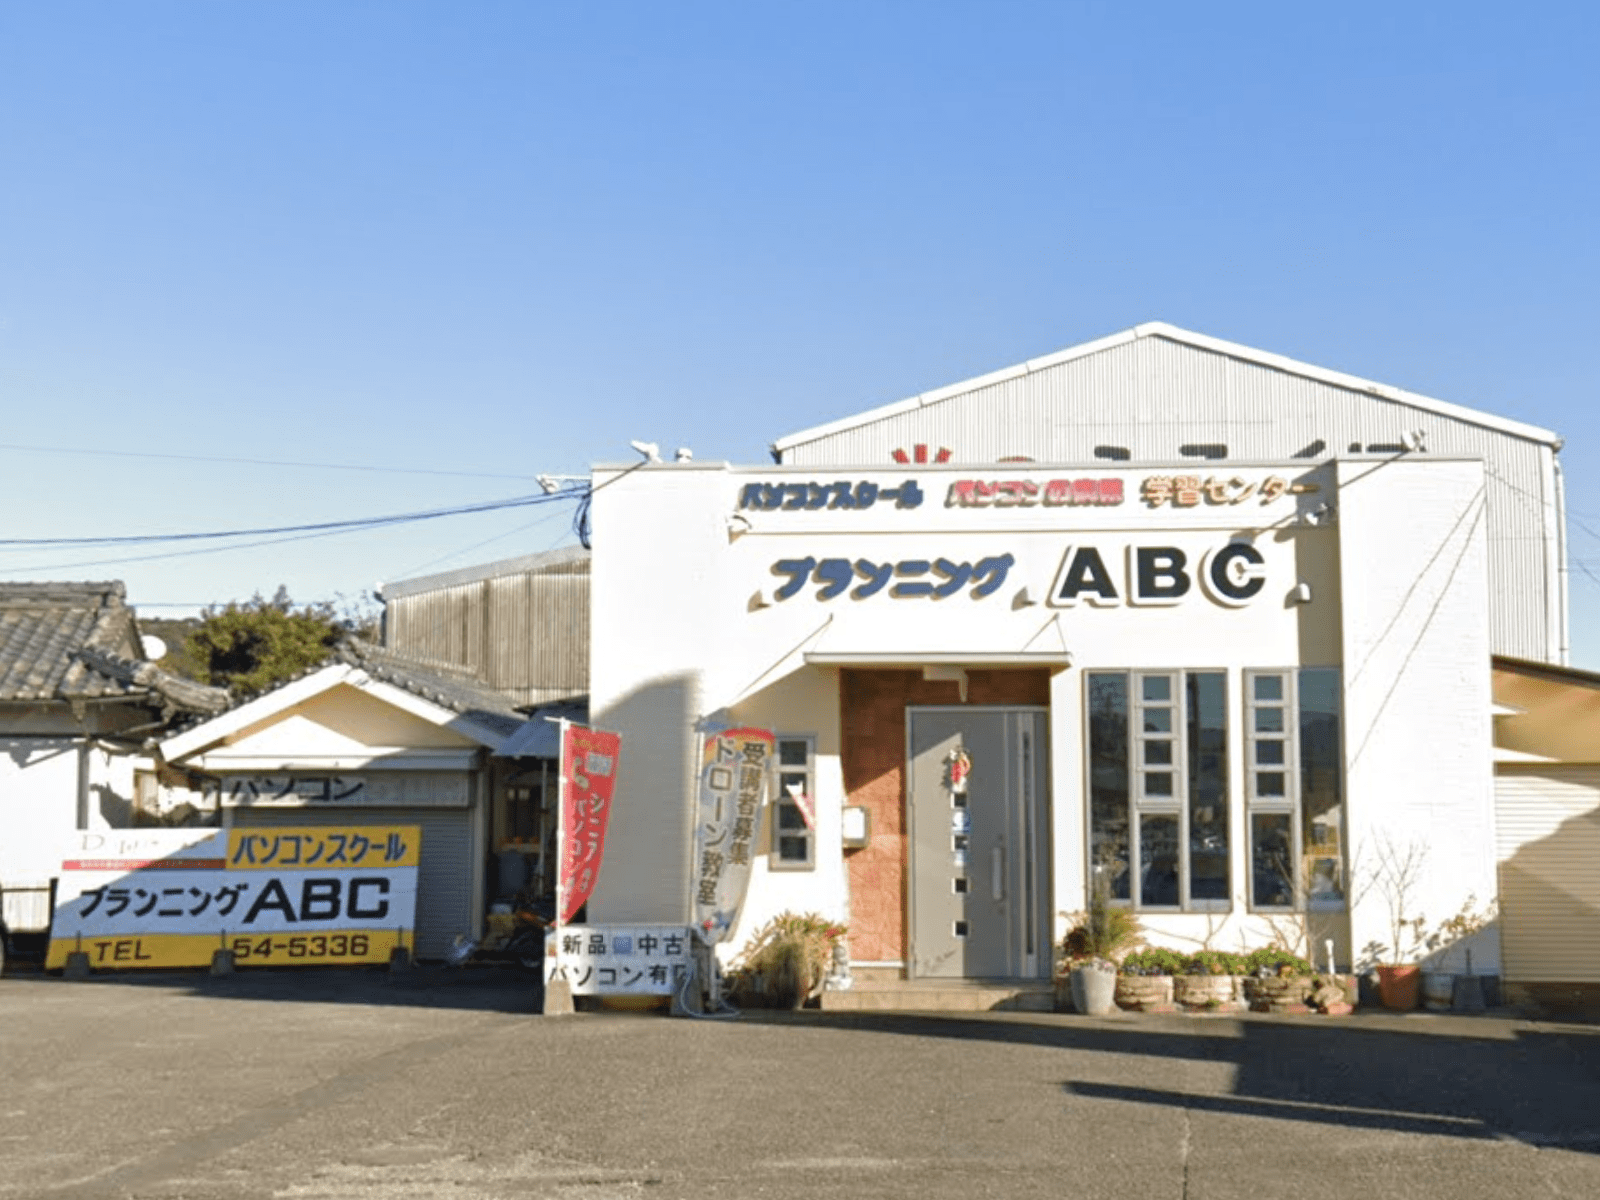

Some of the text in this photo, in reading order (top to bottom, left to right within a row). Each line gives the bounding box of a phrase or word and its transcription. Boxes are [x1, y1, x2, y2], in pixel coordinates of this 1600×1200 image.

[741, 480, 924, 509] パソコンスクール
[1144, 475, 1306, 506] 学習センター
[772, 542, 1266, 600] プランニング ABC
[229, 777, 364, 801] パソコン
[232, 833, 407, 865] パソコンスクール
[79, 877, 390, 924] プランニング ABC
[94, 935, 369, 962] TEL 54-5336
[562, 933, 684, 955] 新品 中古
